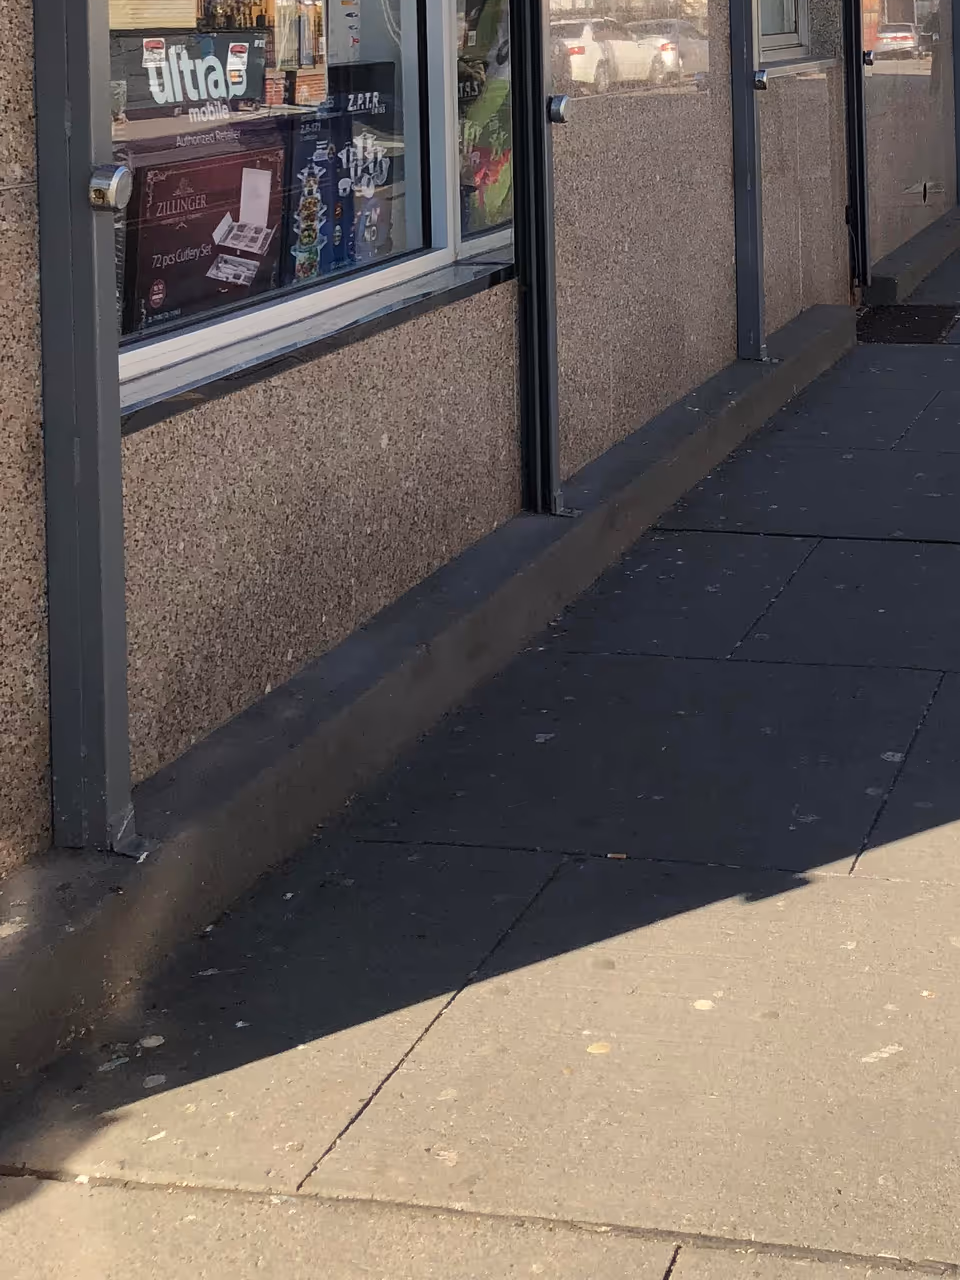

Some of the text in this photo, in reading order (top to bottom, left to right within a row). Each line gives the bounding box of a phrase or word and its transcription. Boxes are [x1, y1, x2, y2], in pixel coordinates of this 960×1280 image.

[148, 45, 226, 105] ultra
[188, 101, 230, 123] mobile
[176, 129, 241, 147] Authorized Retailer
[156, 194, 207, 217] ZILLINGER
[152, 243, 212, 269] 72 pcs Cutlery Set
